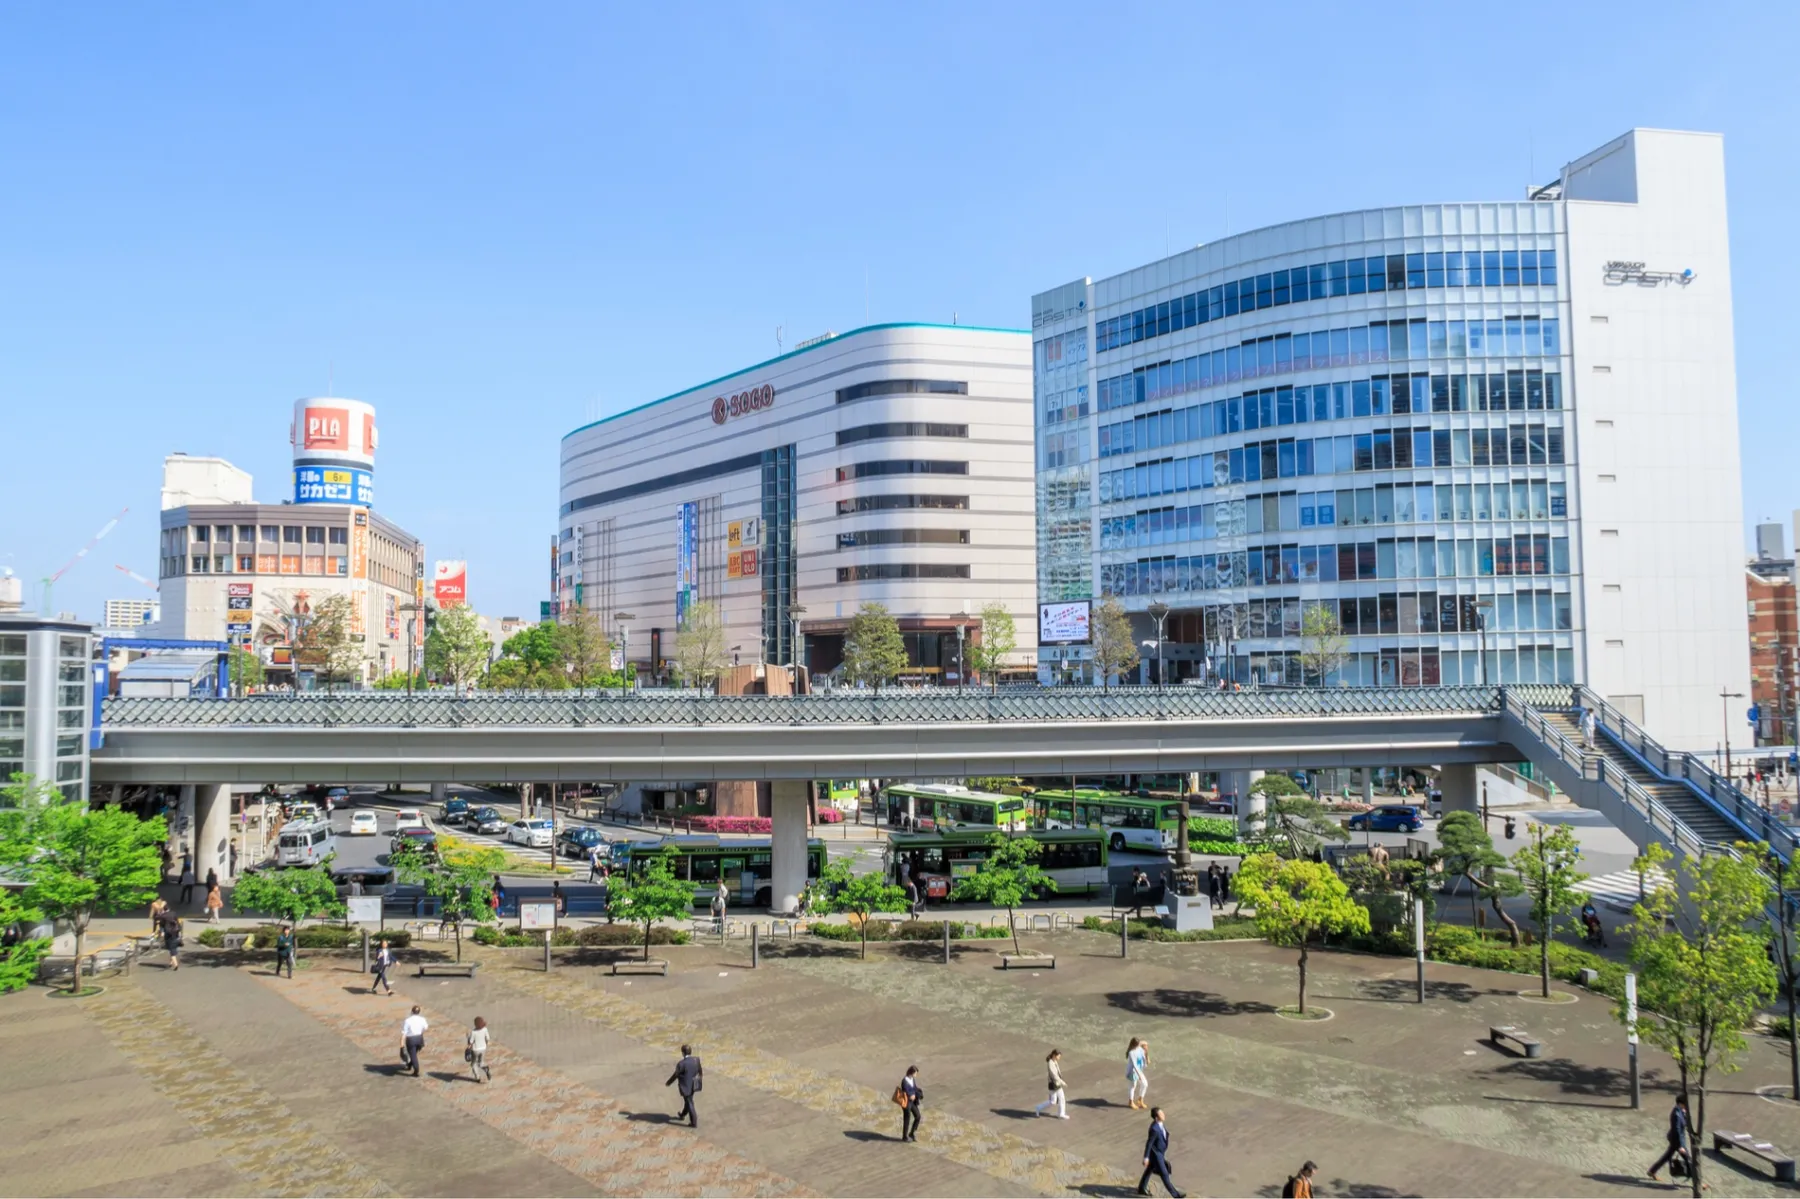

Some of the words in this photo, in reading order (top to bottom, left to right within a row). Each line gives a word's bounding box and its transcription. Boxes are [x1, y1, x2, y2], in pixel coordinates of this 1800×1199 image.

[730, 384, 774, 417] SOGO
[309, 417, 341, 437] PIA
[300, 484, 351, 499] サカゼン
[440, 585, 461, 593] アコム
